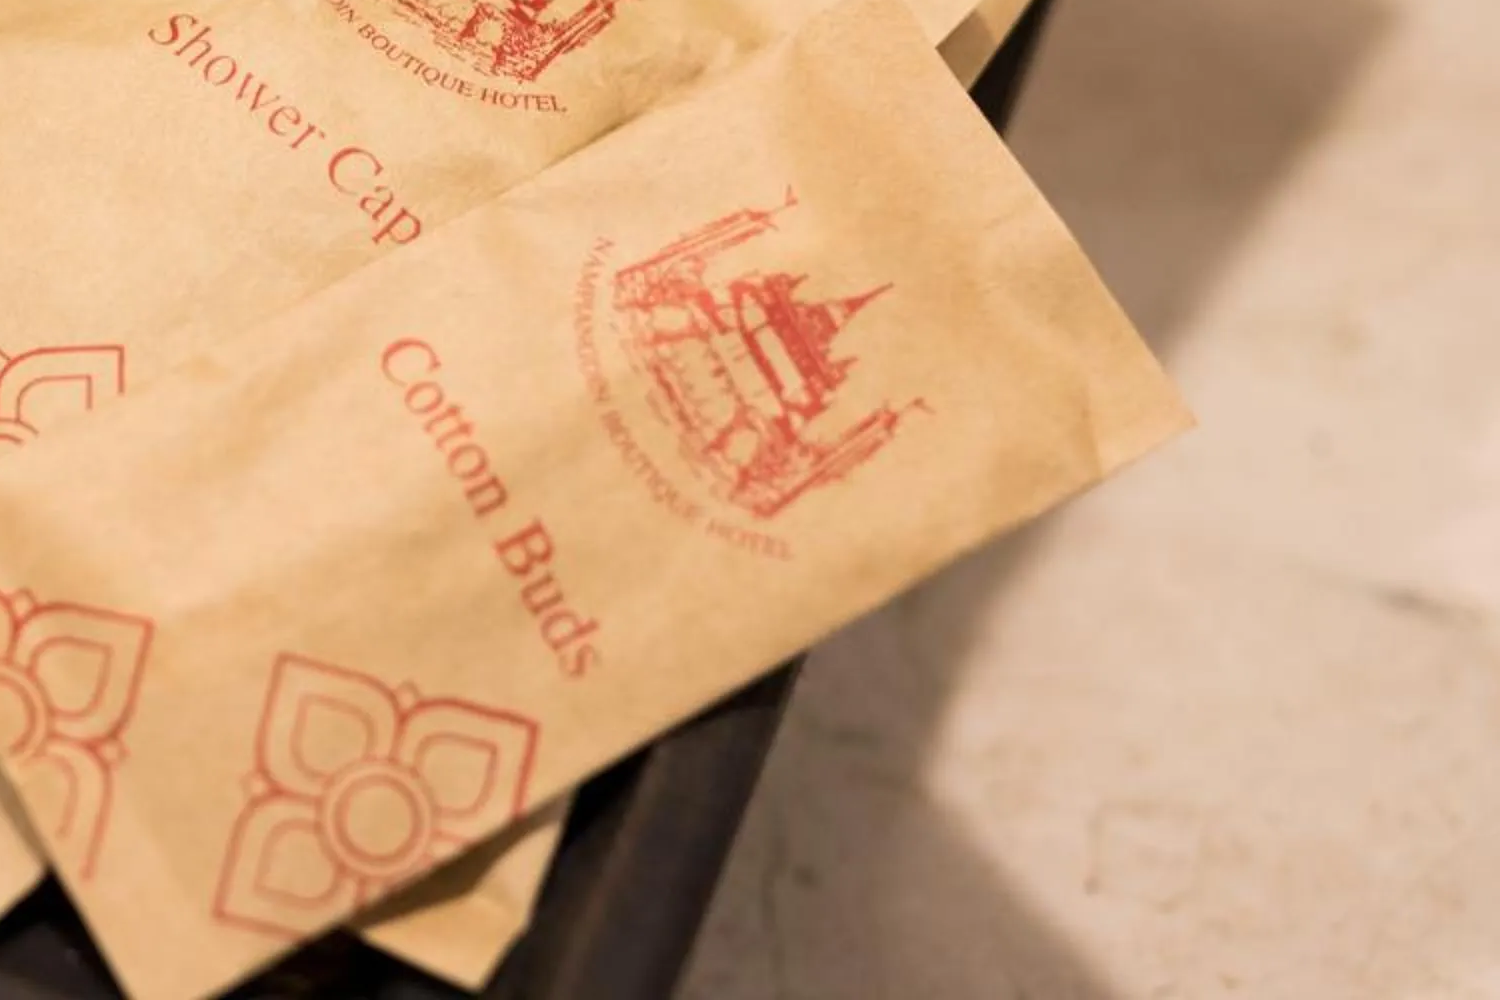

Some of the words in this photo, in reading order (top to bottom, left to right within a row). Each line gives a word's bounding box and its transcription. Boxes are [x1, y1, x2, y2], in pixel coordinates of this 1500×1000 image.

[148, 12, 326, 149] Shower
[327, 146, 422, 246] Cap
[357, 21, 474, 96] BOUTIQUE
[479, 85, 569, 114] HOTEL
[380, 336, 509, 520] Cotton
[492, 517, 600, 681] Buds
